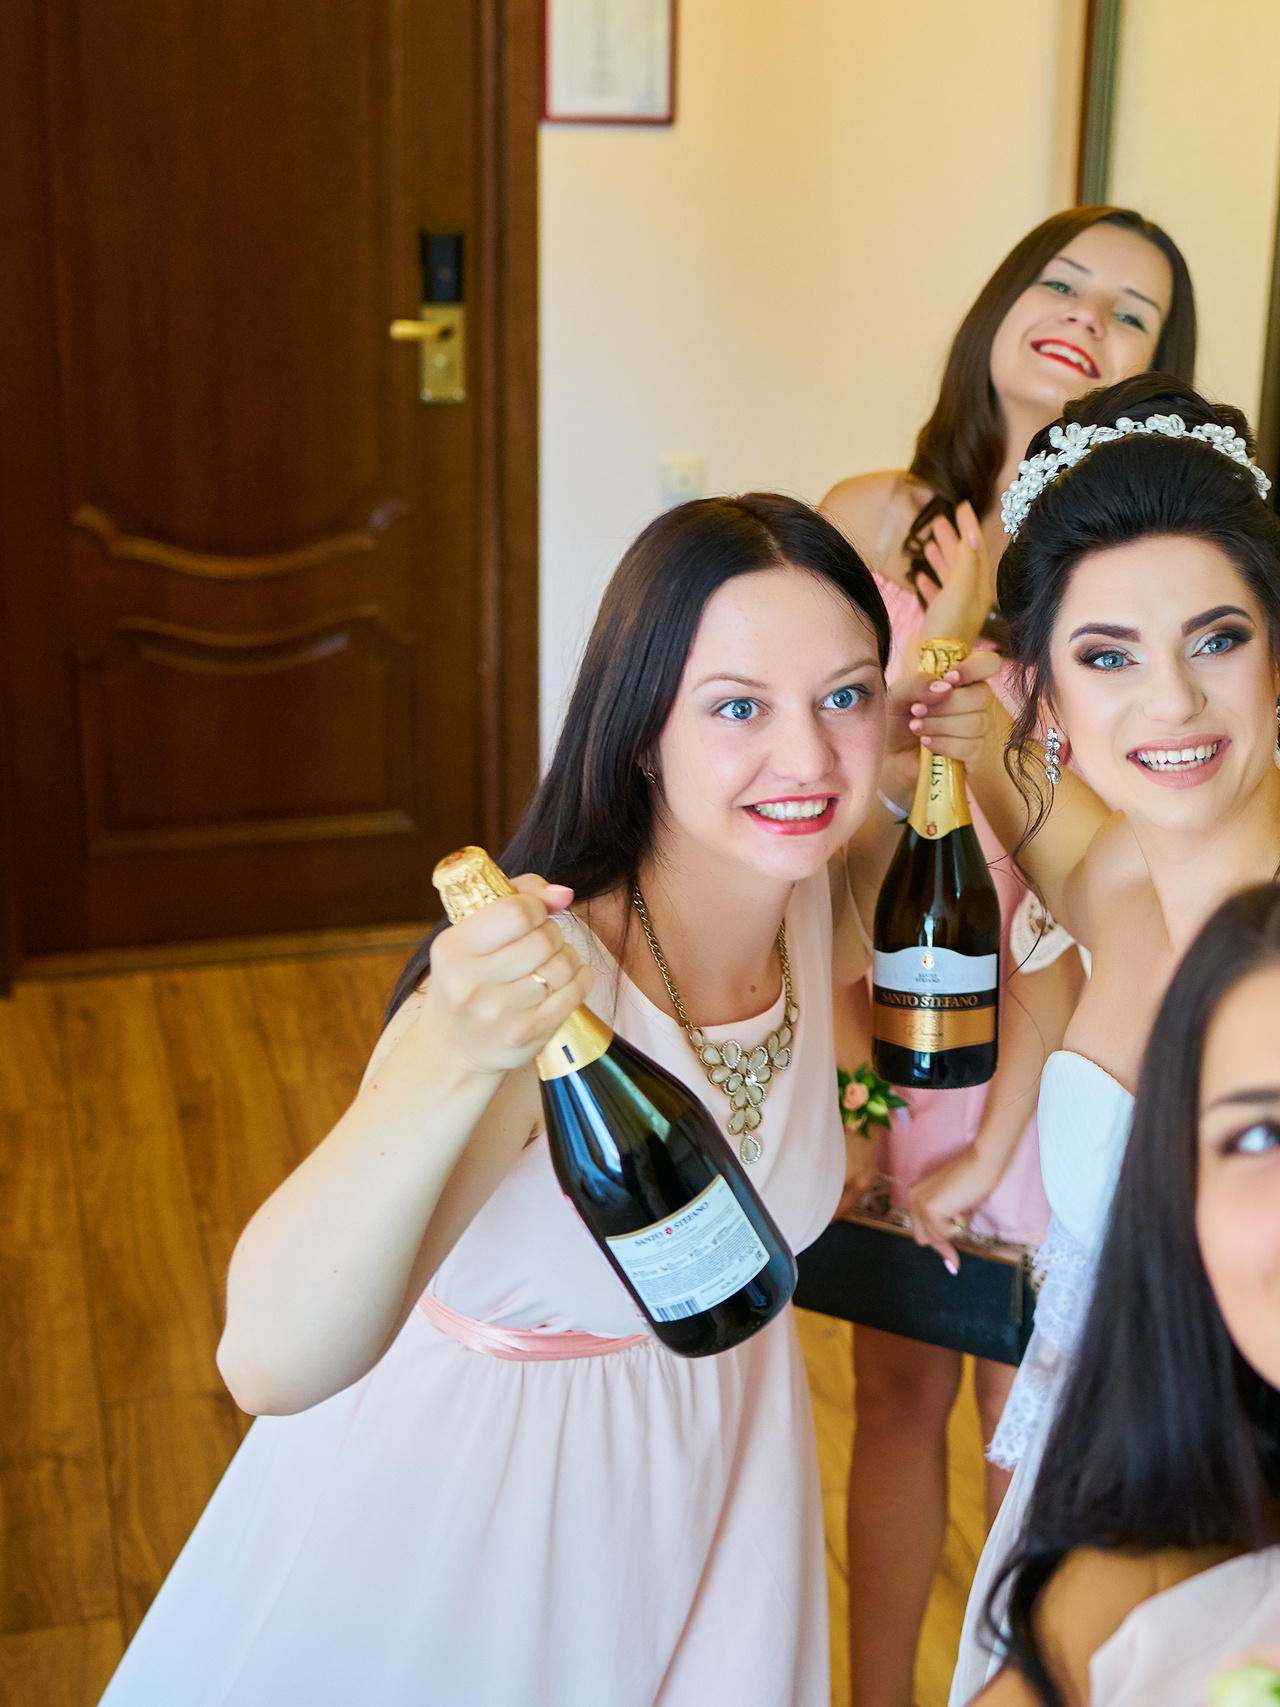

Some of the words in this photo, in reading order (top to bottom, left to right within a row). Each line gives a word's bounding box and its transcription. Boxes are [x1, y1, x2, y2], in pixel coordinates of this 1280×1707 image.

[882, 992, 918, 1007] SANTO
[920, 995, 979, 1008] STEFANO
[634, 1231, 663, 1246] SANTO
[673, 1201, 709, 1229] STEFANO
